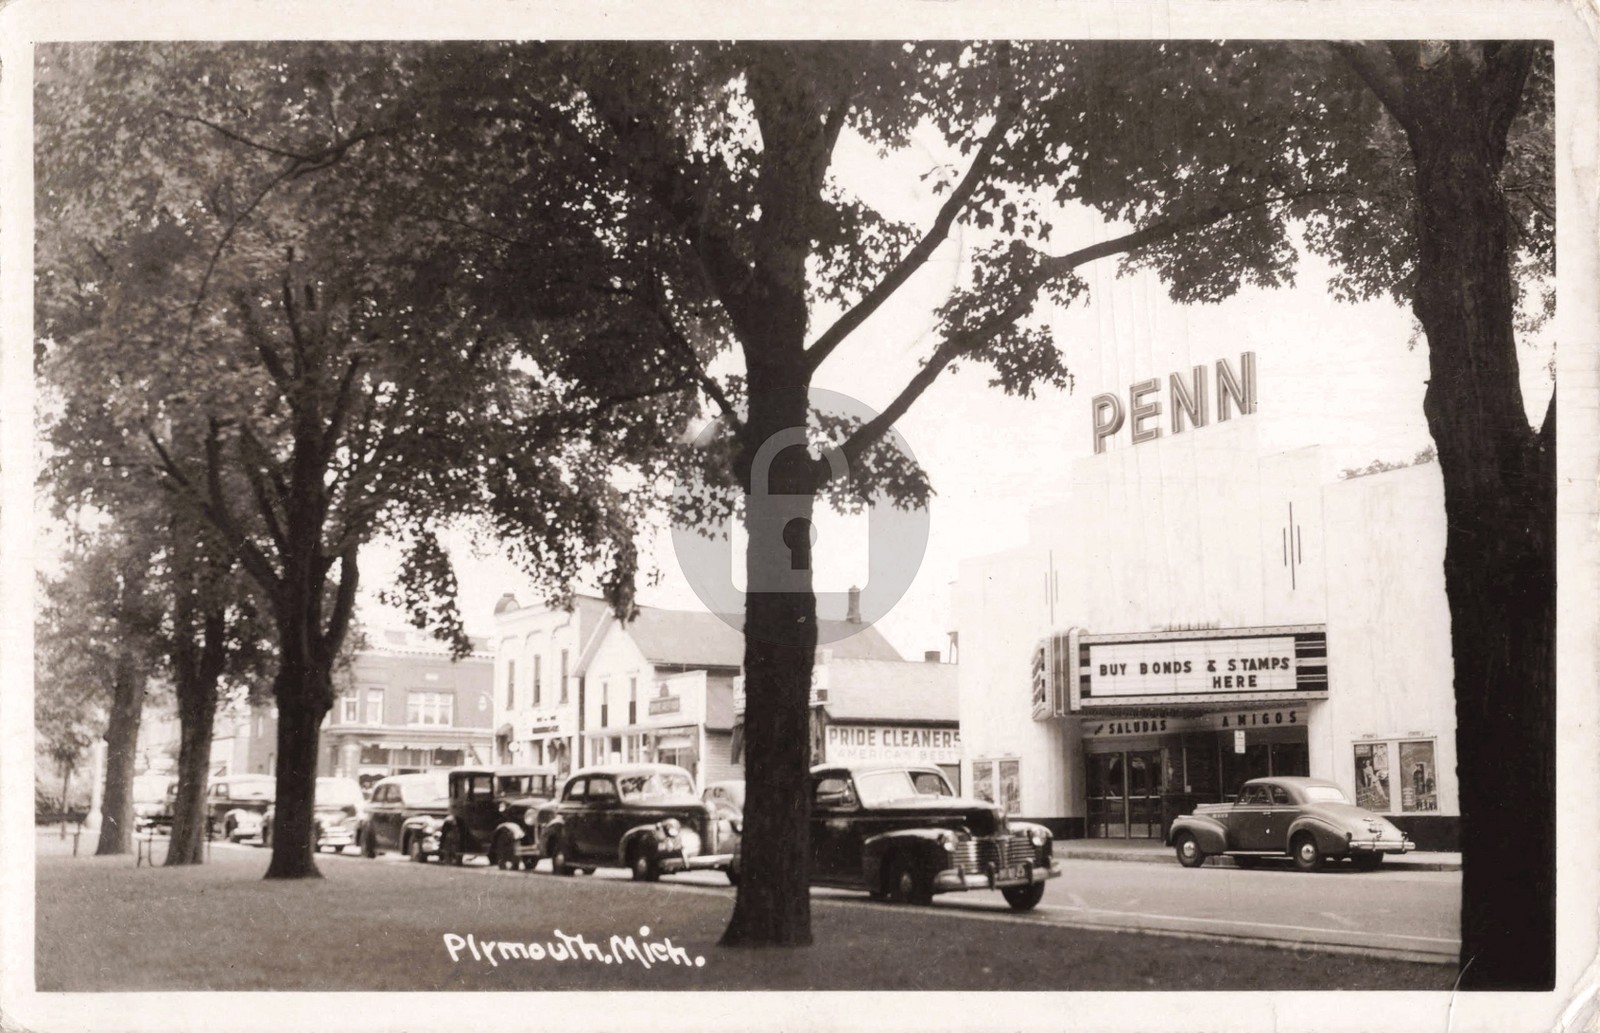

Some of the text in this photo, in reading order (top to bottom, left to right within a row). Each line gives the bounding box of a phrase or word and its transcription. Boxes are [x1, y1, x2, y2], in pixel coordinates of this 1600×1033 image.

[1092, 351, 1258, 455] PENN
[1100, 657, 1291, 677] BUY BONDS & STAMPS
[1213, 675, 1258, 689] HERE
[1222, 711, 1298, 728] AMIGOS
[829, 728, 960, 749] PRIDE CLEANERS
